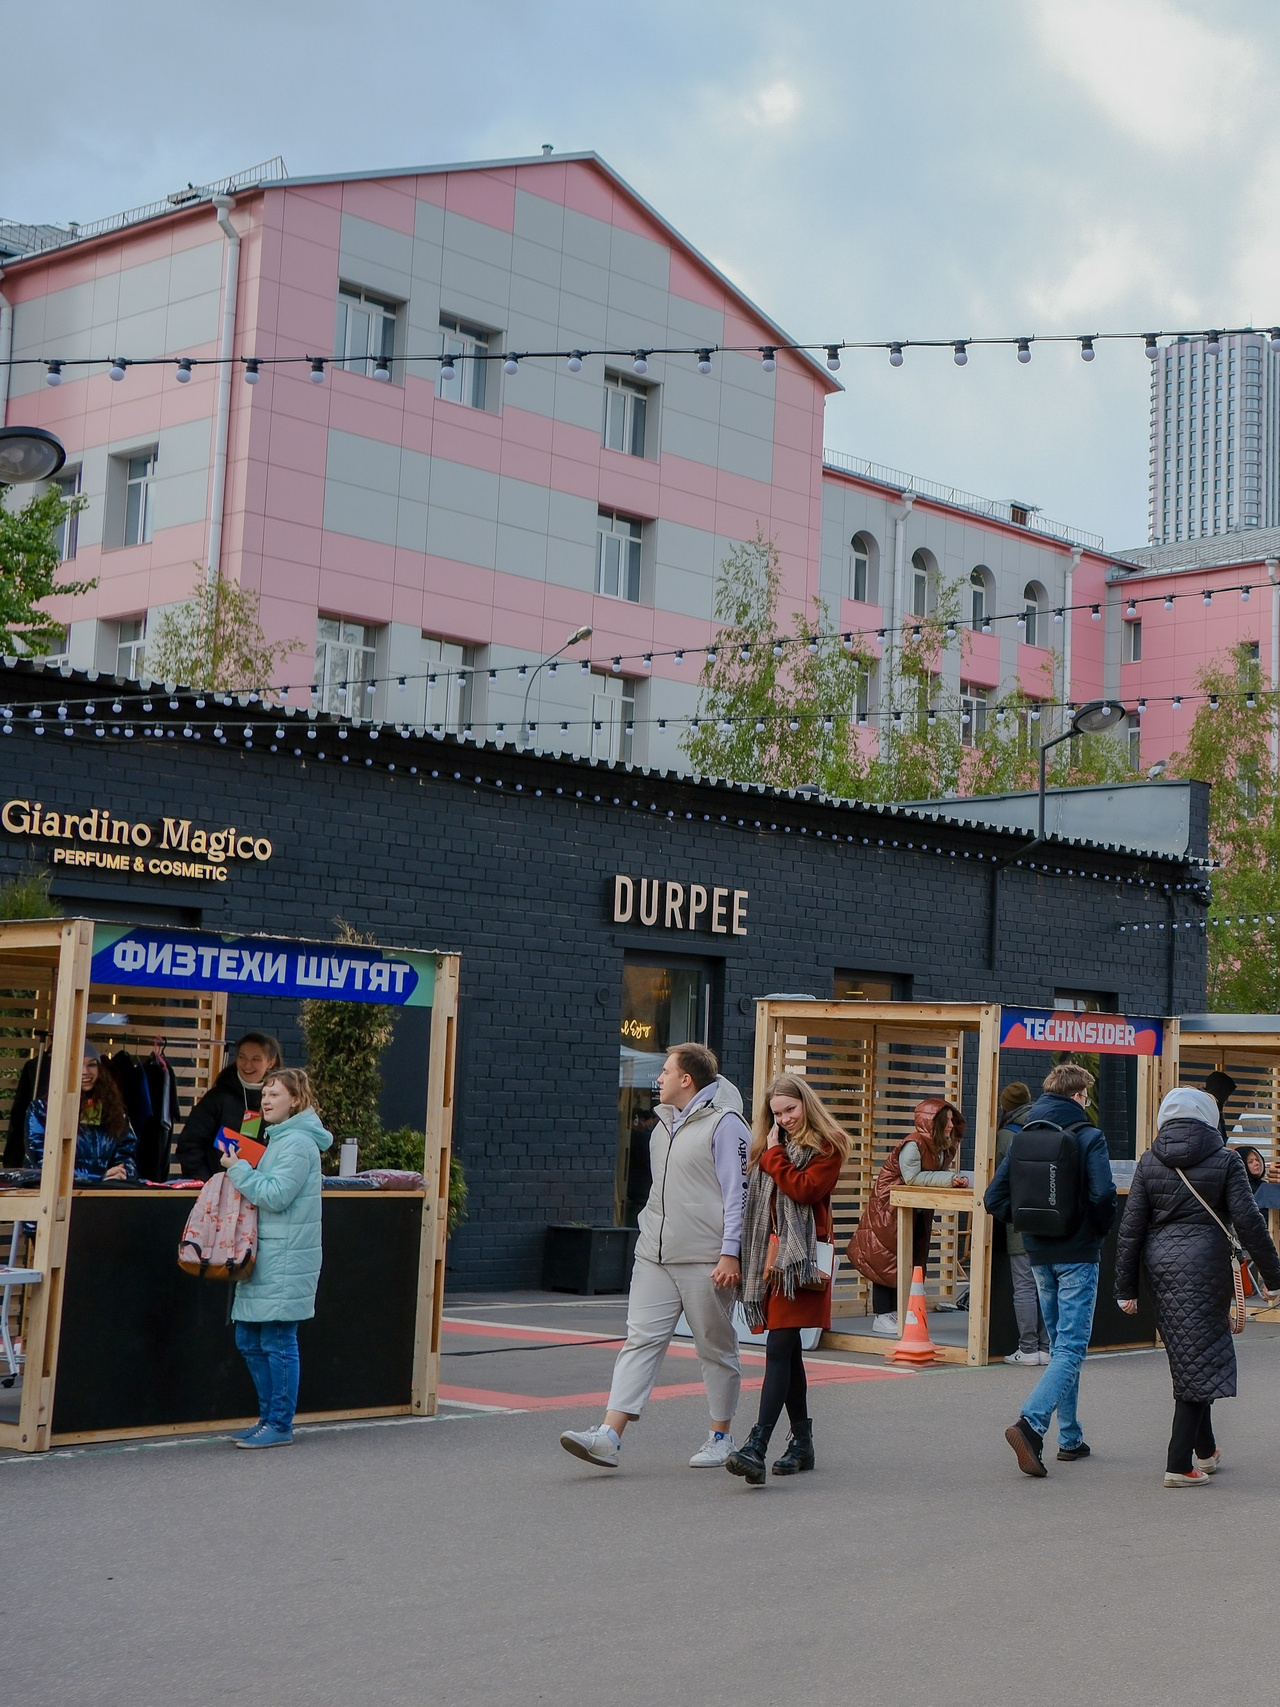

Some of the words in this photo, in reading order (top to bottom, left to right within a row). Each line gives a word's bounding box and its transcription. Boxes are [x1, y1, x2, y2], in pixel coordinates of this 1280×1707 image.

[1, 799, 152, 847] Giardino
[160, 817, 273, 863] Magico
[53, 848, 130, 871] PERFUME
[133, 857, 145, 873] &
[149, 858, 229, 882] COSMETIC
[614, 875, 748, 935] DURPEE
[112, 940, 288, 983] ФИЗТЕХИ
[296, 954, 410, 993] ШУТЯТ
[1024, 1017, 1135, 1046] TECHINSIDER
[1049, 1163, 1057, 1205] discovery
